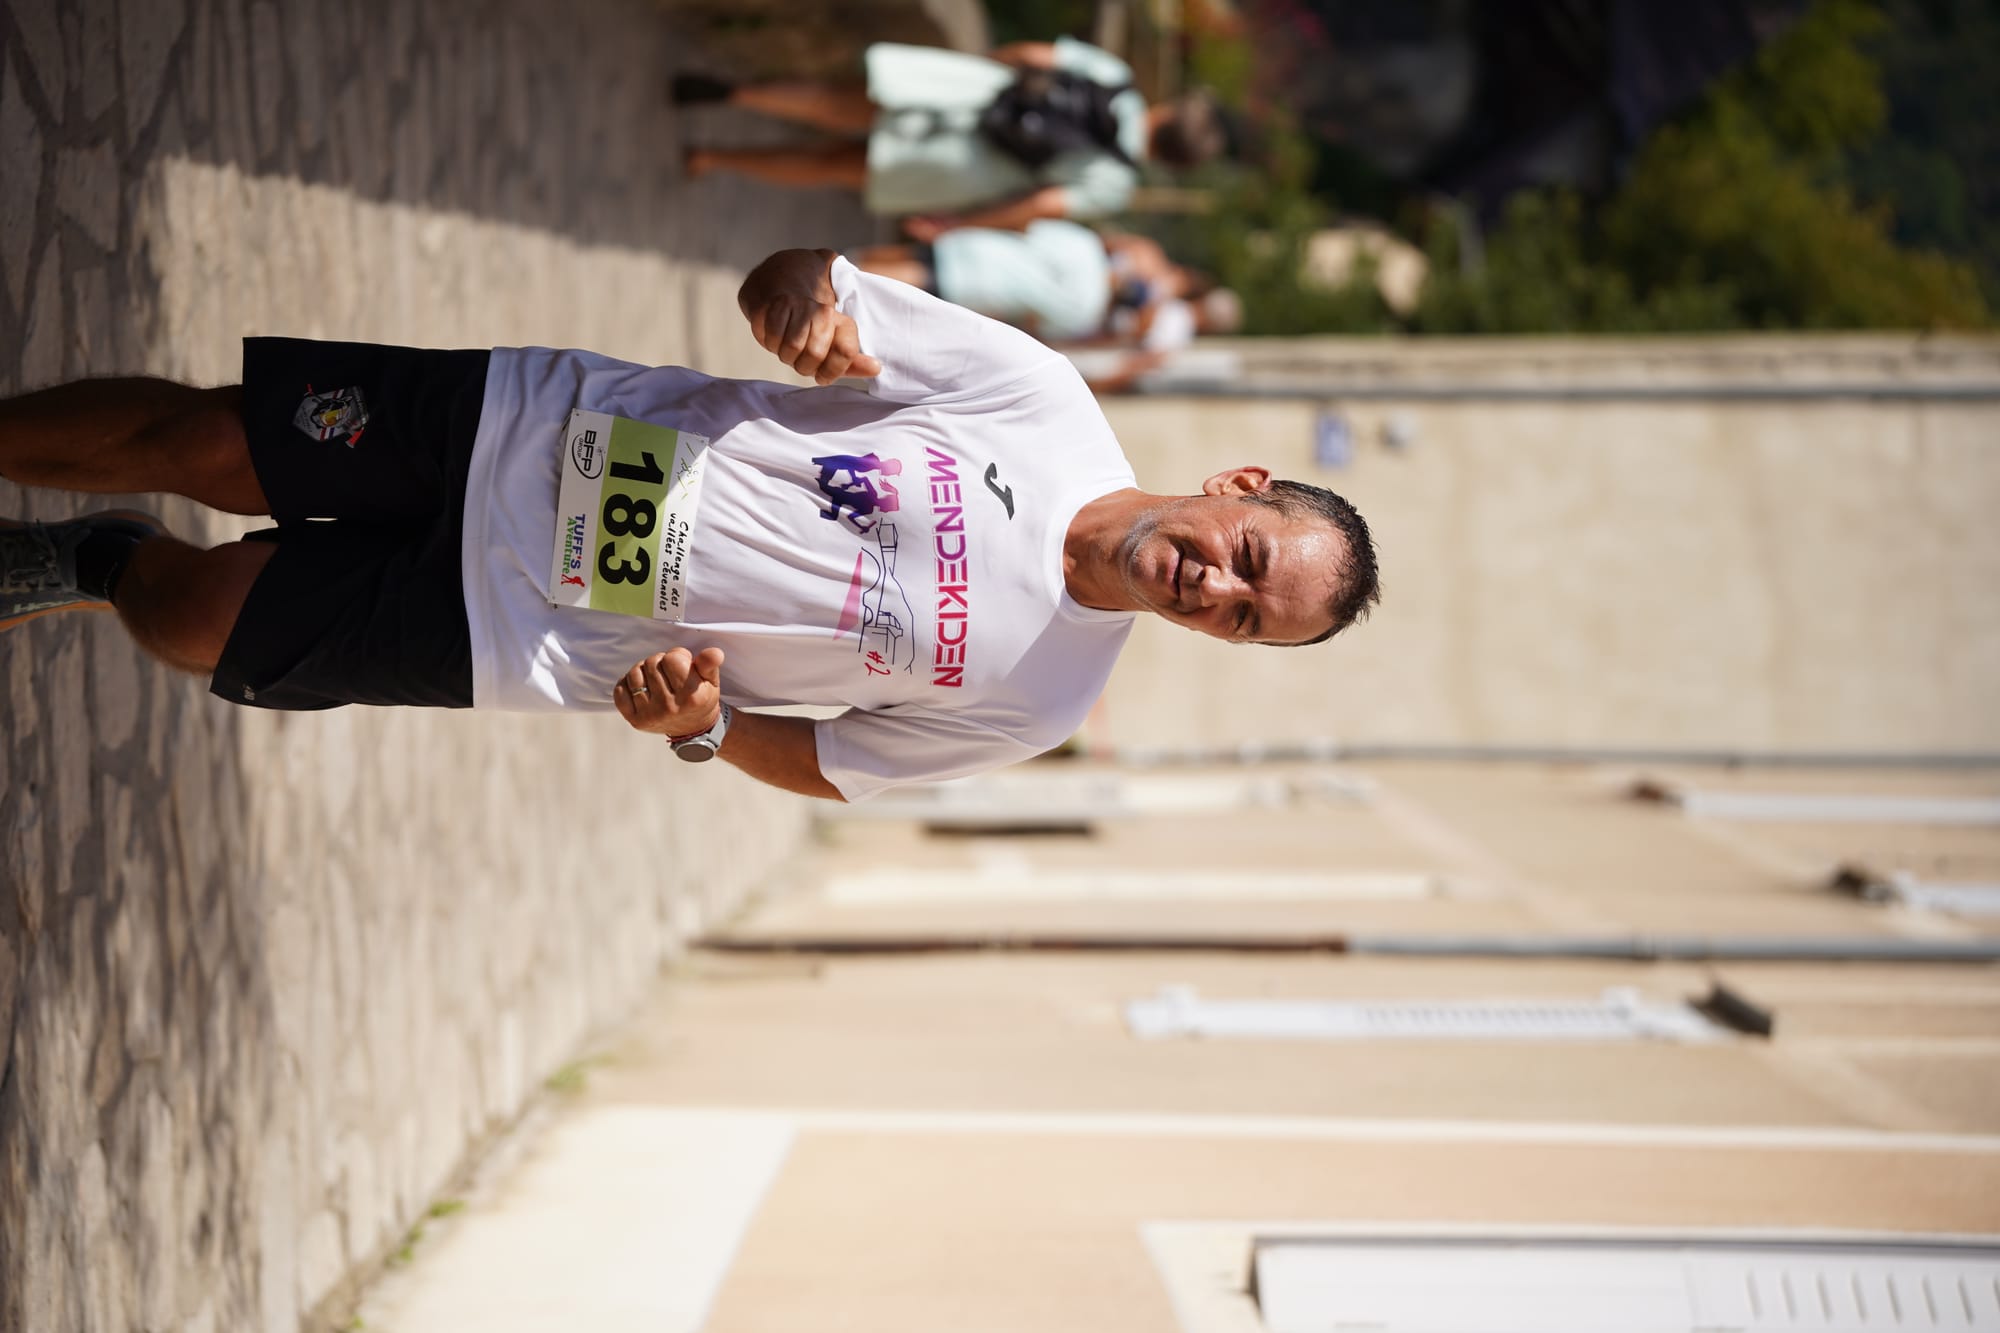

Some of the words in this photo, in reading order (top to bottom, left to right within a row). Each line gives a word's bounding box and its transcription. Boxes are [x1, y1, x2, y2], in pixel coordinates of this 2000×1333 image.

[576, 437, 584, 459] GROUP
[581, 430, 597, 472] BFP
[570, 513, 586, 570] TUFF'S
[598, 451, 665, 586] 183
[664, 512, 677, 554] vallées
[561, 516, 577, 575] Aventure
[671, 521, 689, 582] Challenge
[924, 446, 968, 688] MENDEKIDEN
[659, 561, 674, 612] cévenoles
[671, 587, 680, 607] des
[864, 650, 891, 677] #2
